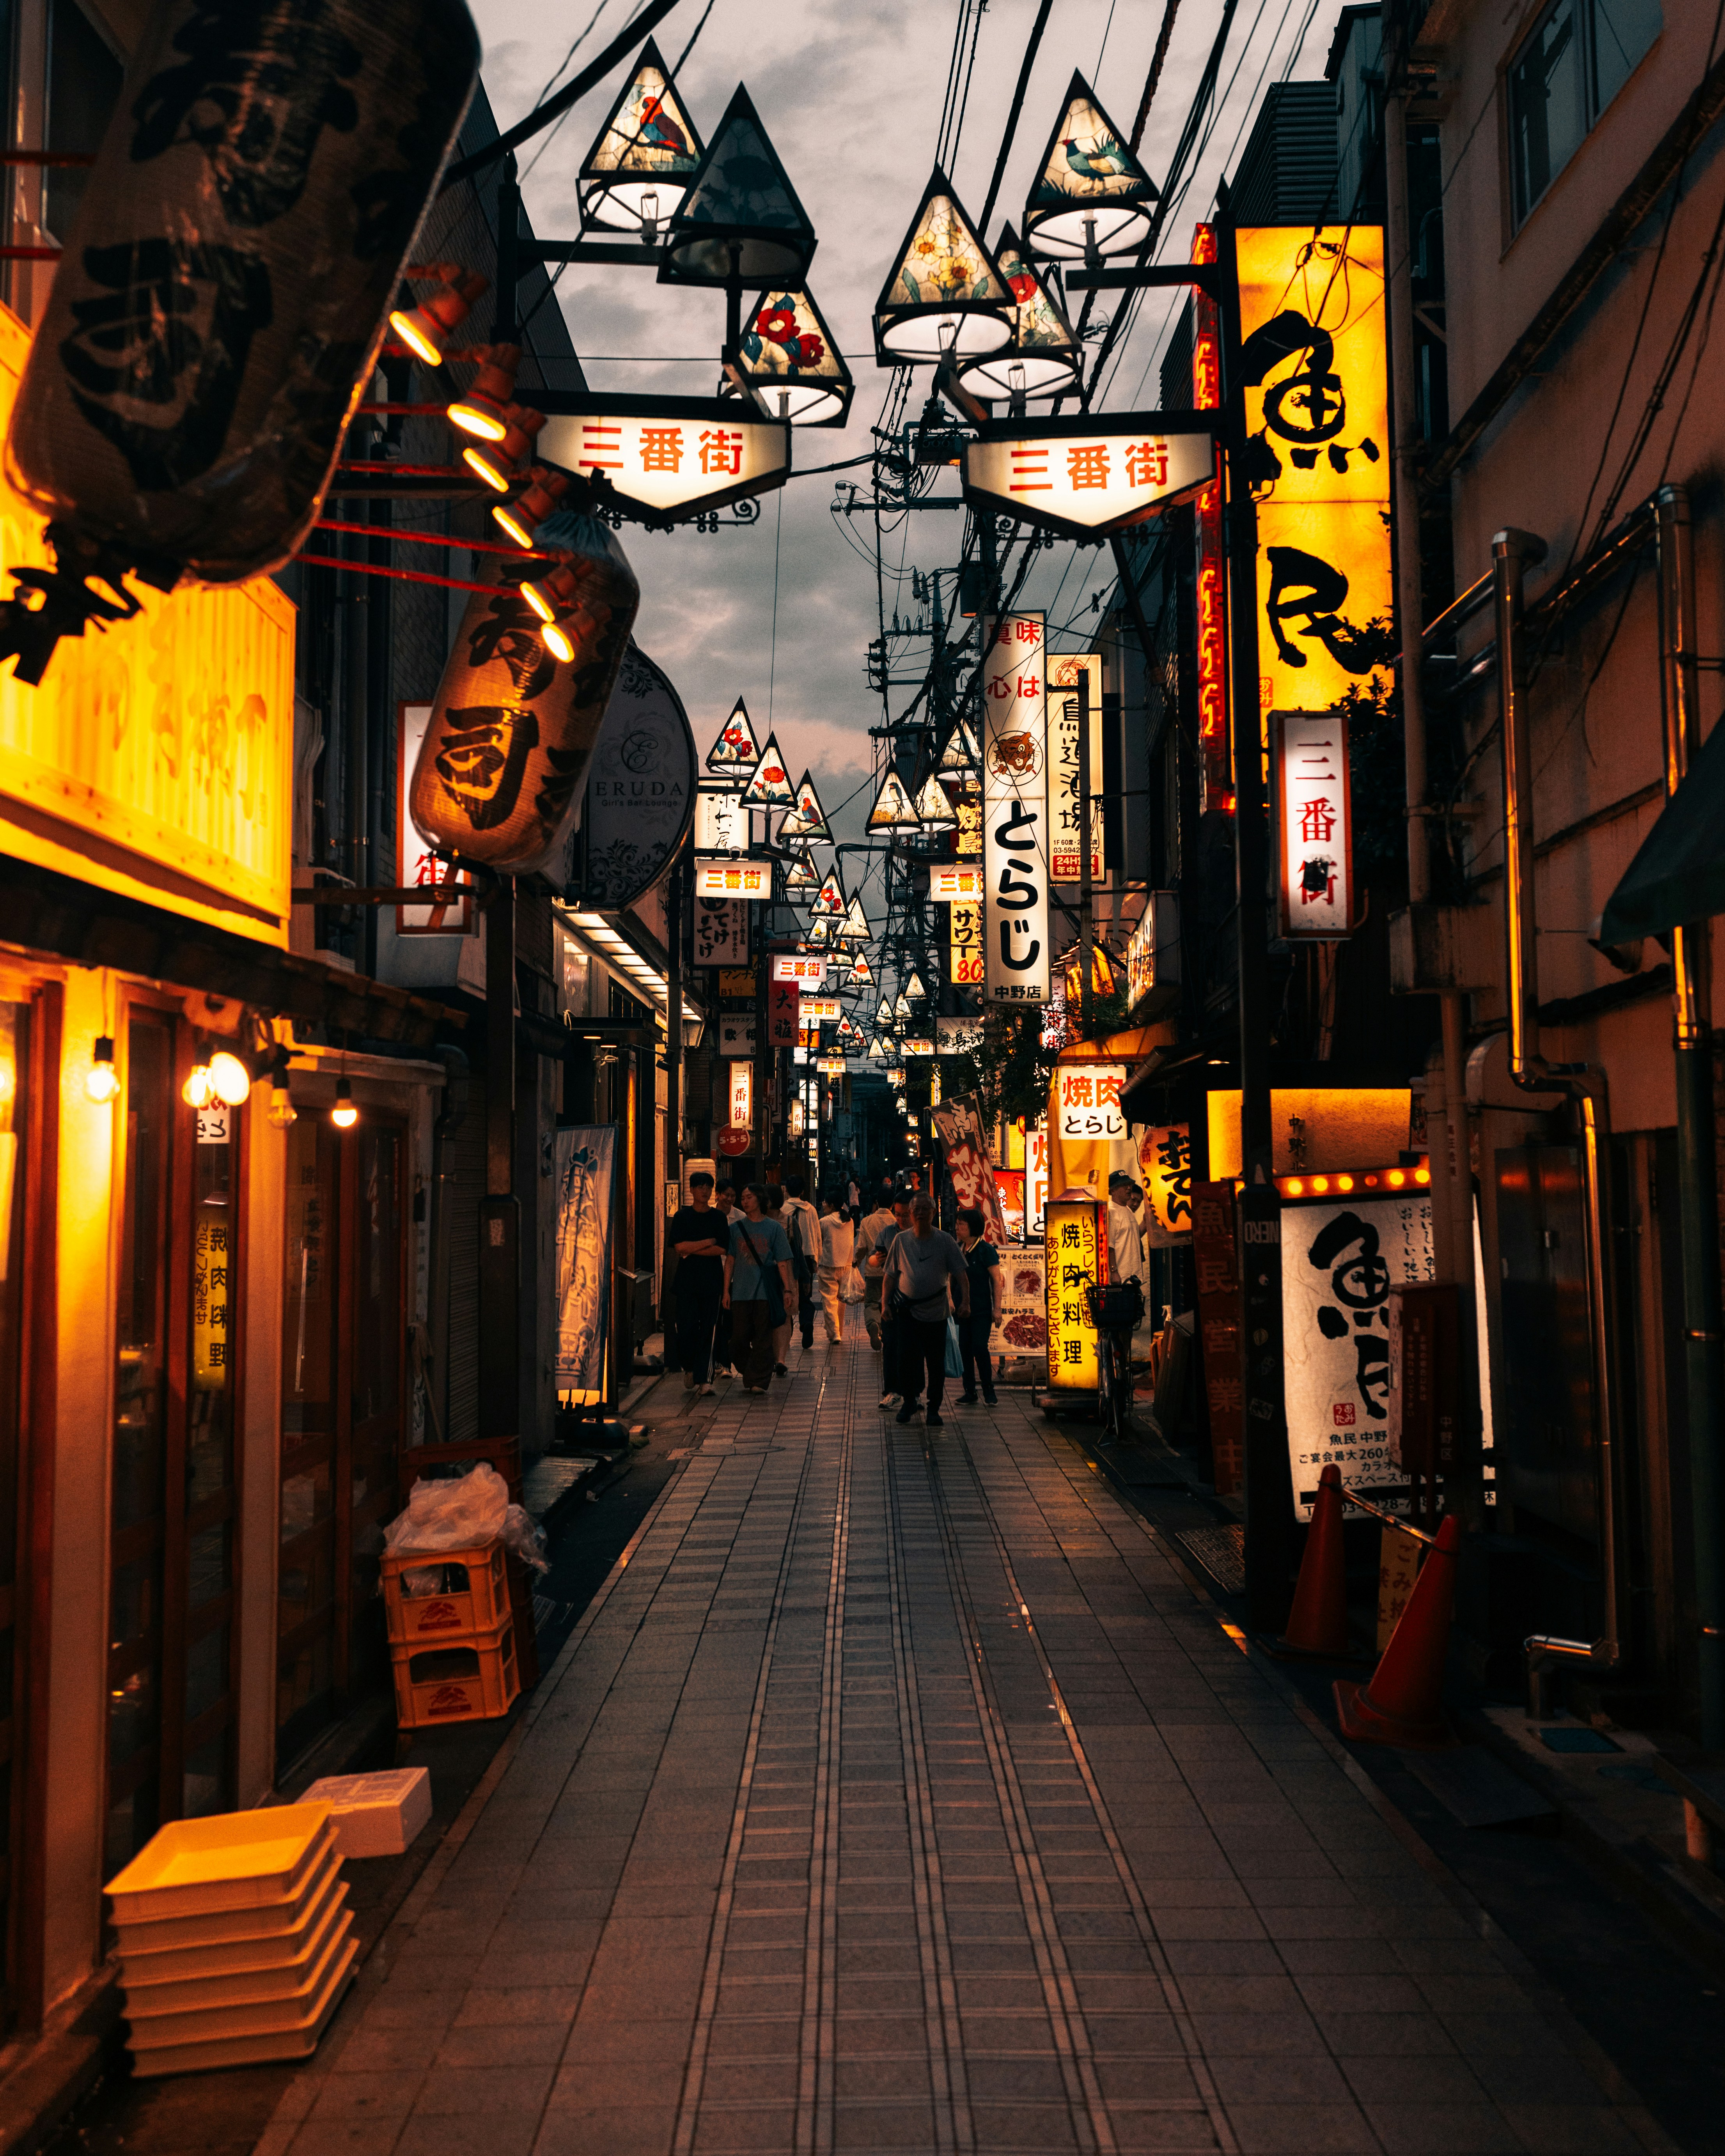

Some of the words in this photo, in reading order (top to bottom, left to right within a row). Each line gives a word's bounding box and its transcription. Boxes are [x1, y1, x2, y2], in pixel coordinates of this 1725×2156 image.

[579, 425, 743, 475] 三番街
[1009, 442, 1168, 491] 三番街
[1242, 309, 1383, 675] 魚民
[596, 781, 683, 796] ERUDA
[706, 870, 761, 890] 三番街
[995, 801, 1041, 971] とらじ
[781, 962, 820, 976] 三番街
[995, 985, 1041, 999] 中野店
[803, 1003, 835, 1015] 三番街
[905, 1043, 929, 1052] 三番街
[734, 1070, 747, 1121] 三番街
[1063, 1075, 1124, 1107] 焼肉
[1064, 1115, 1123, 1134] とらじ
[1047, 1236, 1061, 1377] ありがとうございます
[1061, 1223, 1083, 1364] 焼肉料理
[1330, 1433, 1357, 1446] 魚民
[1360, 1430, 1388, 1443] 中野
[1440, 1416, 1453, 1461] 中野区
